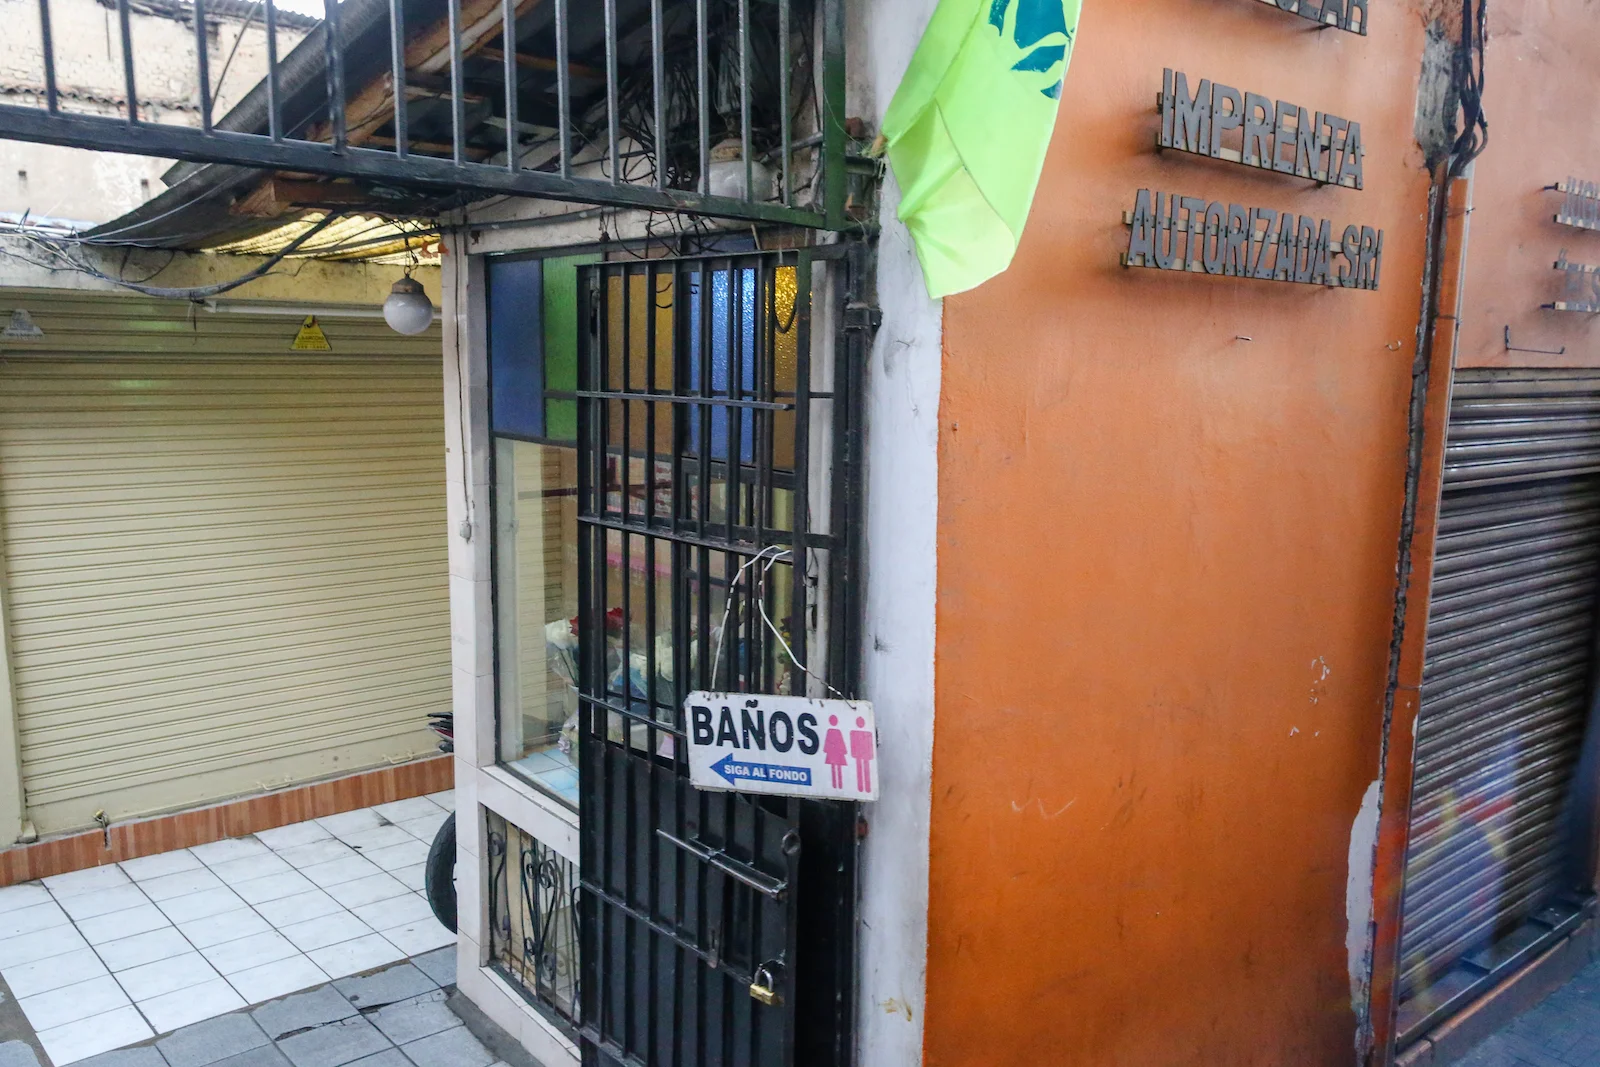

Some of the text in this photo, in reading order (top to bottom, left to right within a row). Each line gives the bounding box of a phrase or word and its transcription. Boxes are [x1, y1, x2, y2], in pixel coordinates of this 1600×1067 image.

[1160, 67, 1363, 190] IMPRENTA
[1127, 188, 1384, 291] AUTORIZADA SRI
[691, 699, 820, 756] BAÑOS
[724, 764, 807, 782] SIGA AL FONDO
